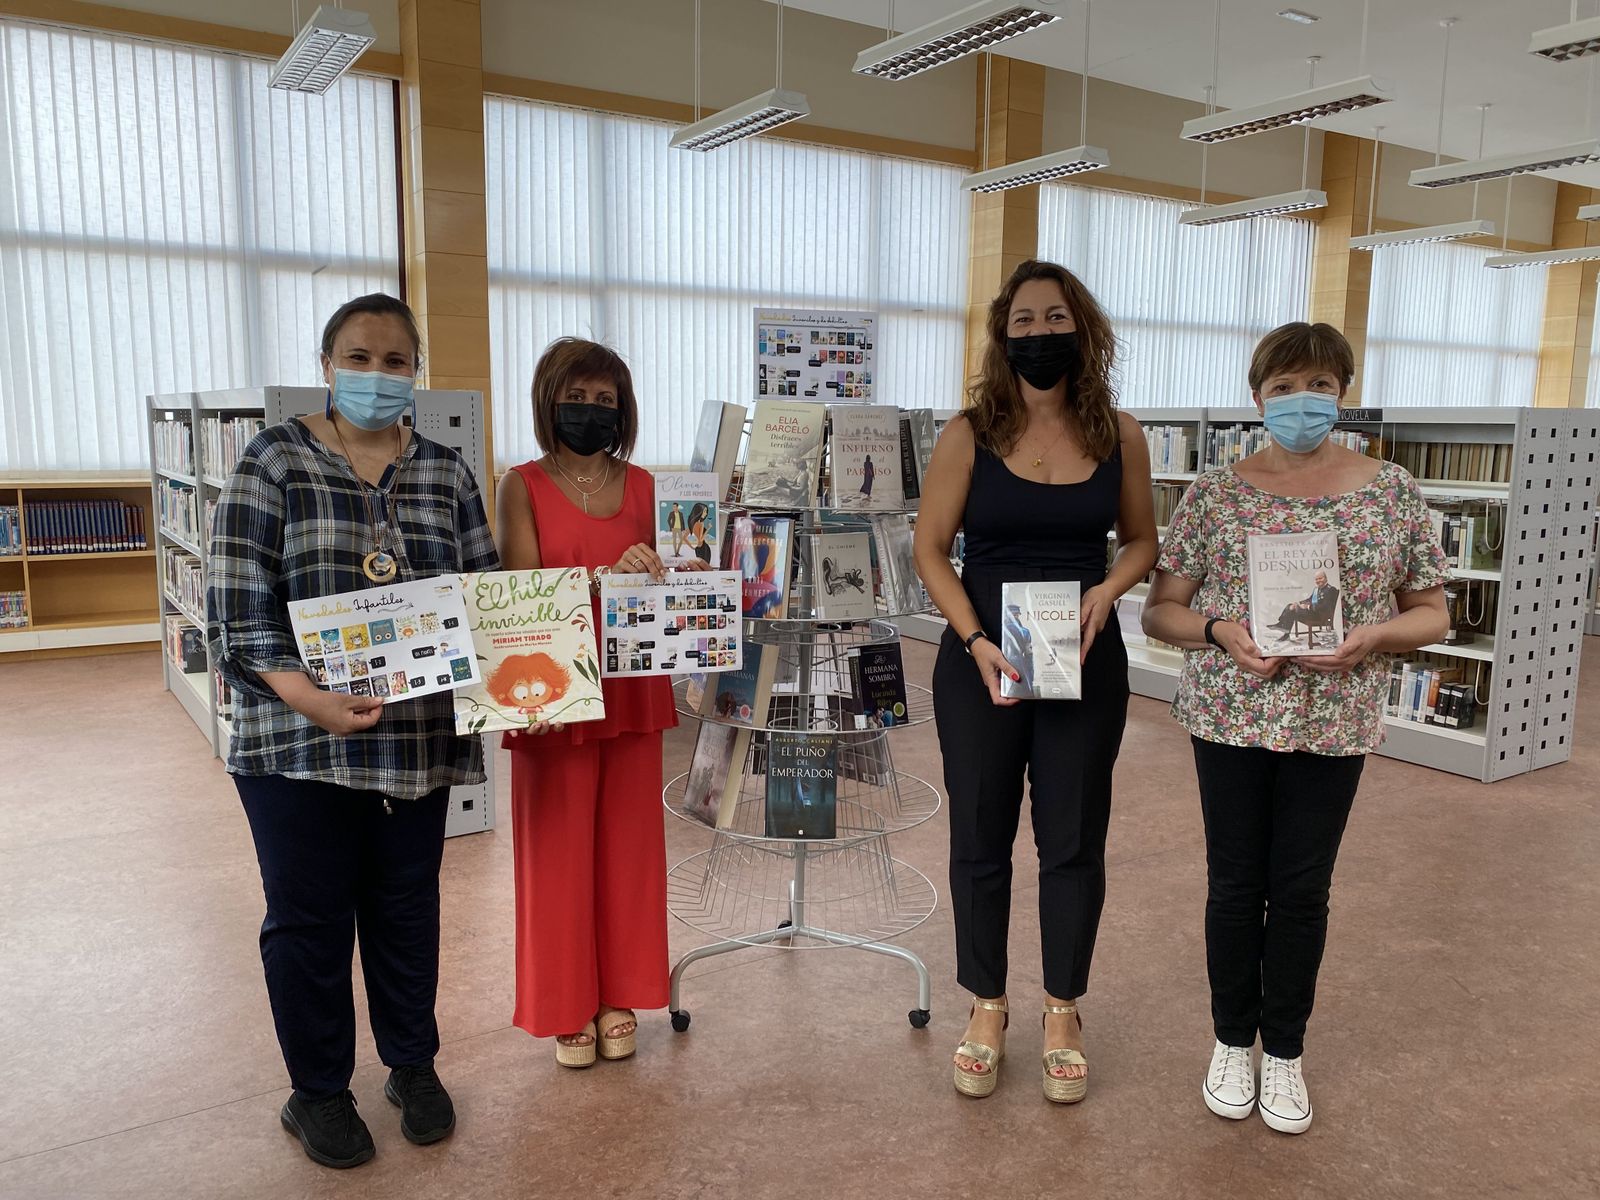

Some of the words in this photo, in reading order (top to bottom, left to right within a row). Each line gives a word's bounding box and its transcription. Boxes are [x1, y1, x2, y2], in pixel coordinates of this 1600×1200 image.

[778, 416, 799, 425] ELIA
[765, 424, 810, 435] BARCELÓ
[842, 444, 894, 453] INFIERNO
[1264, 551, 1280, 560] EL
[1283, 549, 1307, 559] REY
[1311, 549, 1328, 557] AL
[1258, 558, 1335, 573] DESNUDO
[475, 581, 509, 612] El
[508, 570, 557, 606] hilo
[477, 602, 563, 631] invisible
[1026, 610, 1076, 621] NICOLE
[492, 636, 522, 645] MIRIAM
[523, 634, 552, 642] TIRADO
[864, 664, 898, 675] HERMANA
[868, 673, 896, 683] SOMBRA
[781, 746, 792, 757] EL
[796, 745, 826, 758] PUÑO
[771, 767, 834, 779] EMPERADOR
